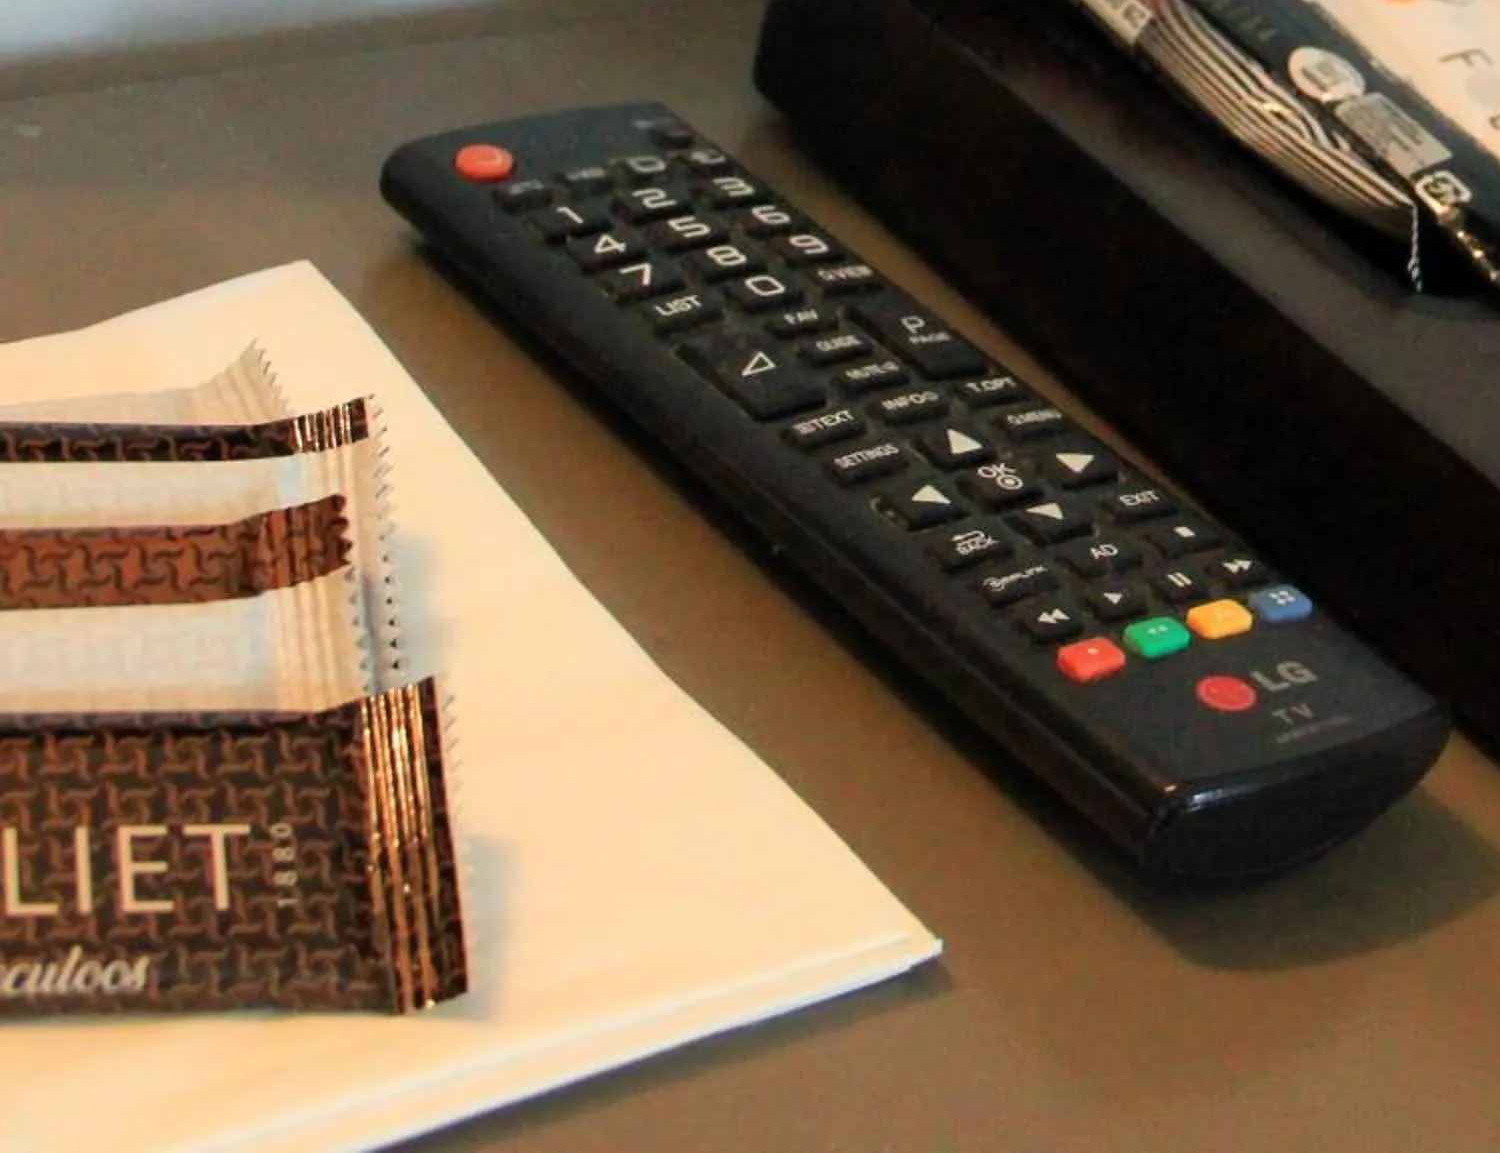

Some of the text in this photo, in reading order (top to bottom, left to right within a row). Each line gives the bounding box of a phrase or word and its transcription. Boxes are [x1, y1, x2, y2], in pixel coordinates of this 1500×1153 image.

[632, 187, 679, 209] 2
[713, 176, 755, 198] 3
[556, 204, 584, 225] 1
[751, 204, 792, 226] 6
[667, 215, 711, 239] 5
[593, 233, 627, 255] 4
[788, 234, 829, 256] 9
[705, 244, 748, 267] 8
[618, 261, 652, 287] 7
[744, 274, 786, 297] 0
[655, 293, 702, 317] LIST
[902, 315, 926, 335] P
[814, 409, 856, 433] TEXT
[833, 443, 900, 469] SETTINGS
[977, 462, 1017, 479] OK
[1119, 489, 1160, 508] EXIT
[1090, 543, 1119, 560] AD
[1252, 660, 1317, 692] LG
[1271, 702, 1314, 725] TV
[4, 823, 250, 916] LIET
